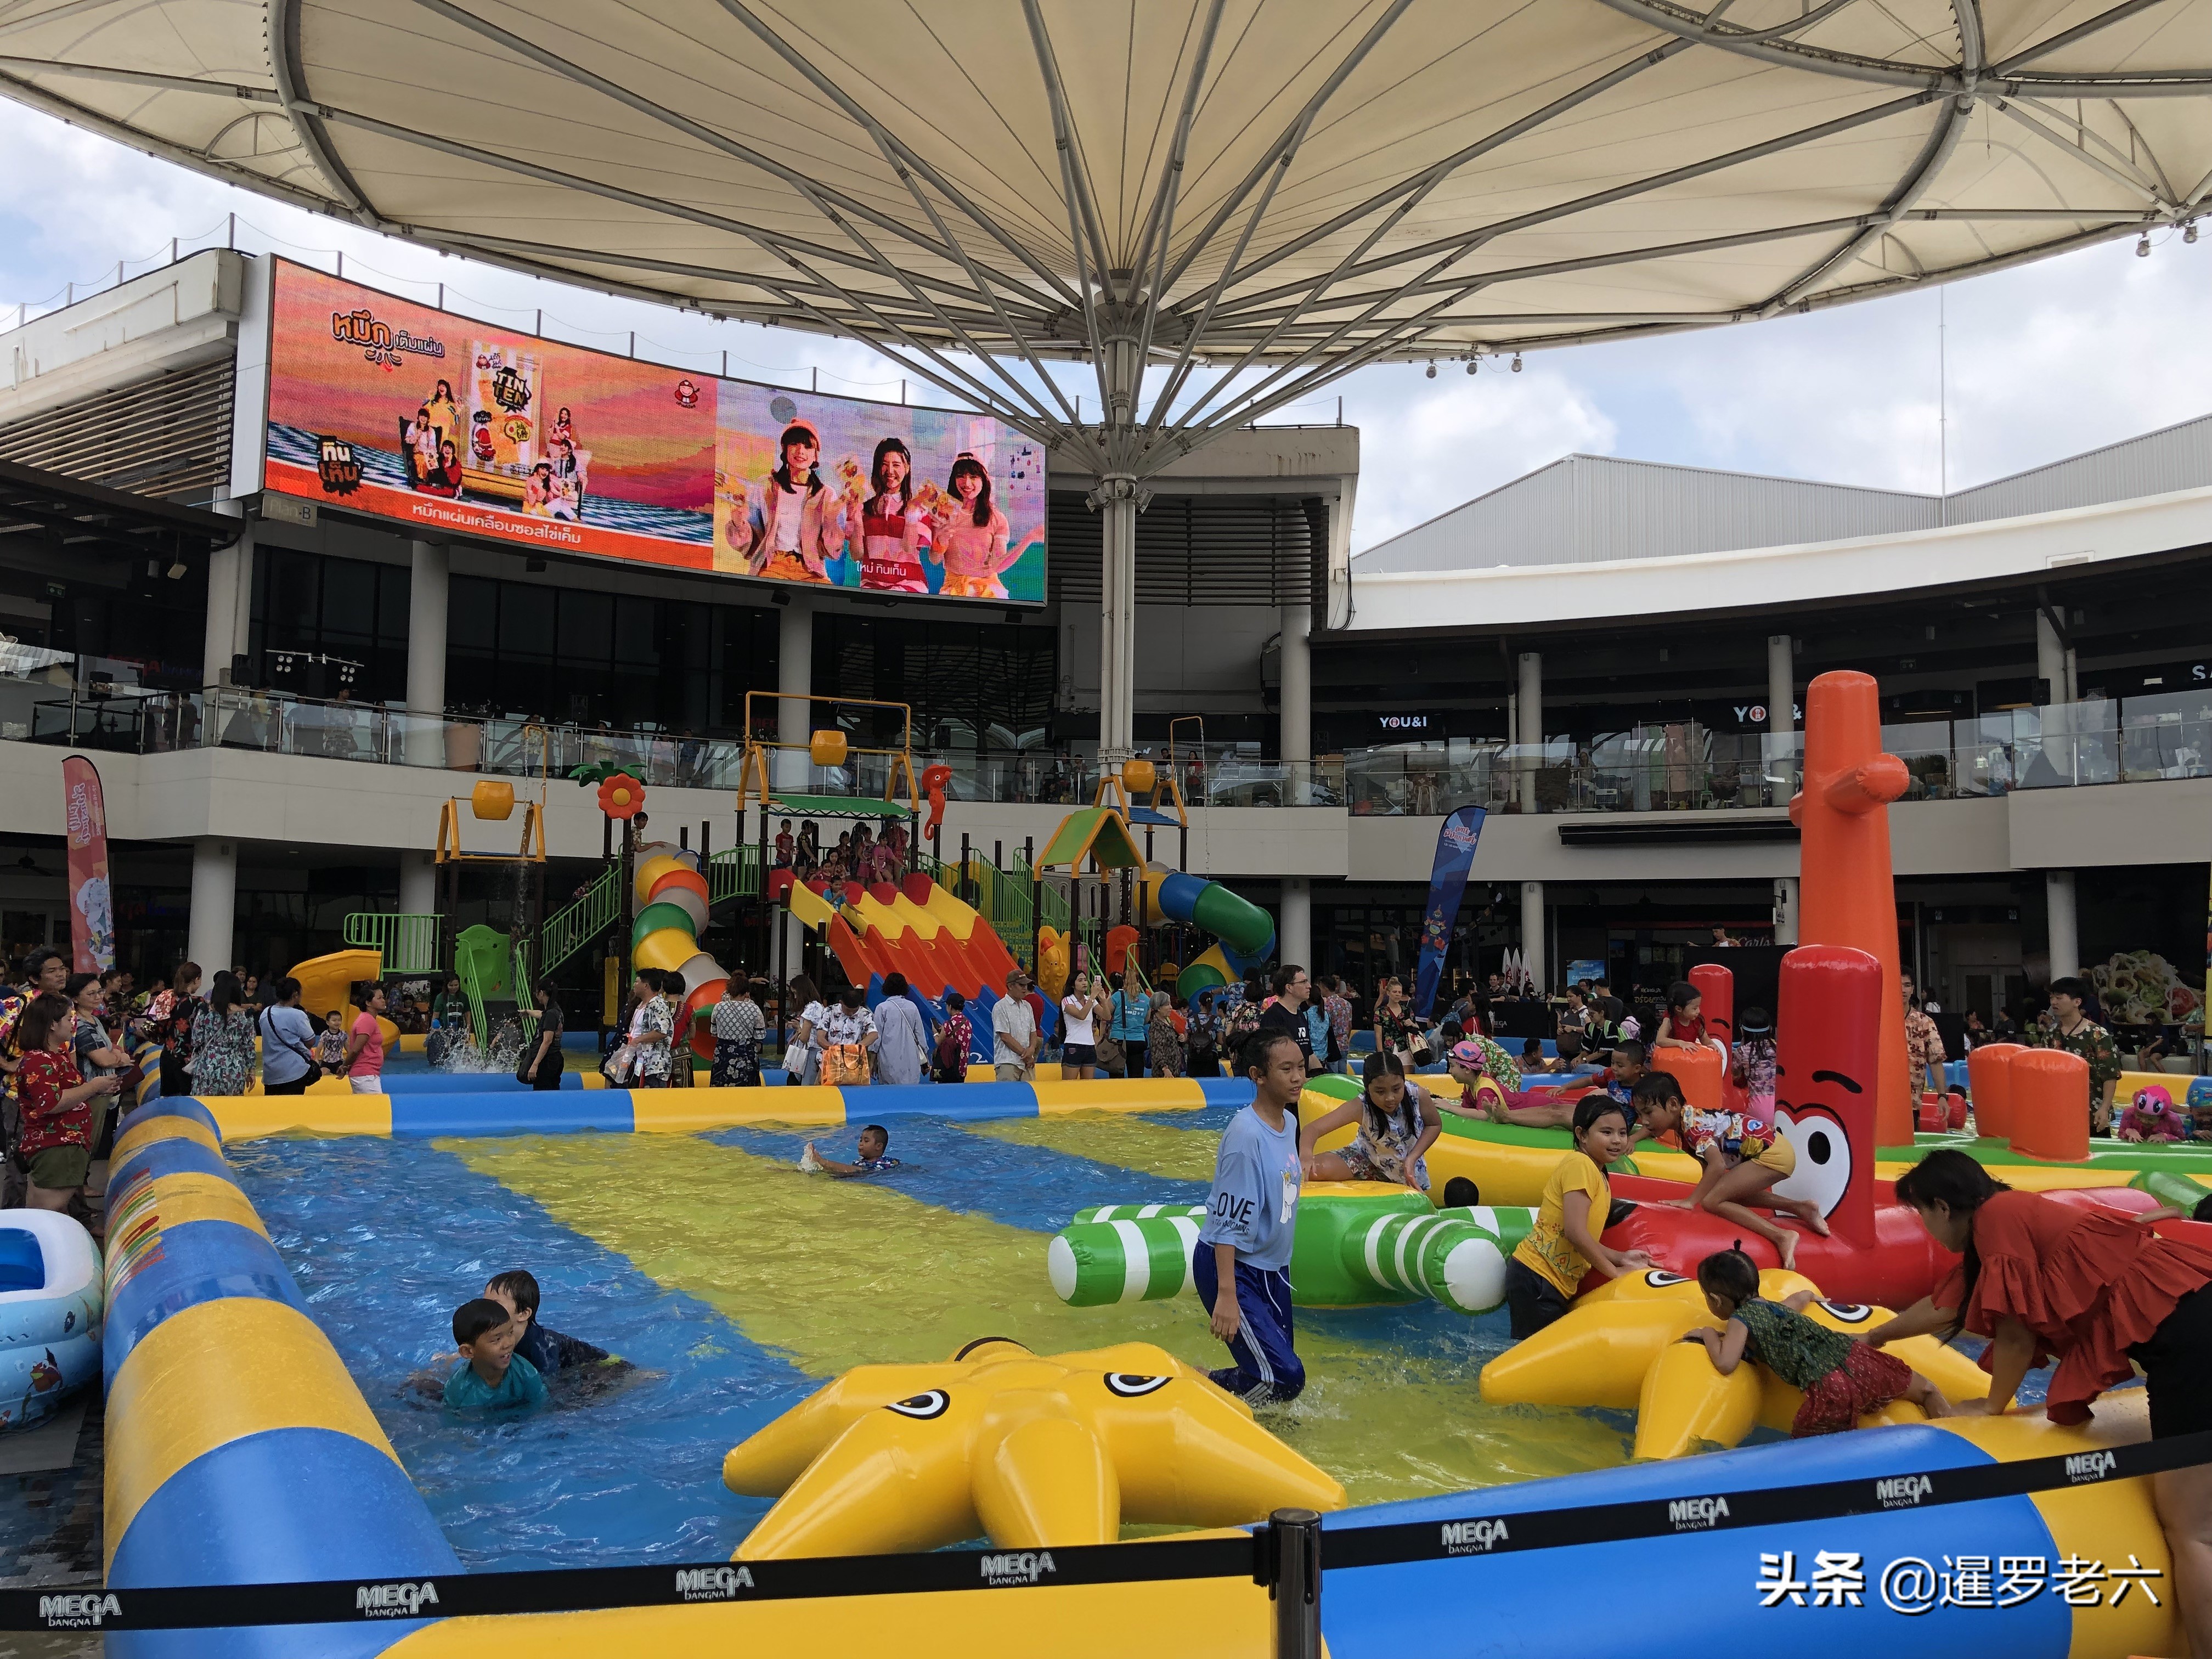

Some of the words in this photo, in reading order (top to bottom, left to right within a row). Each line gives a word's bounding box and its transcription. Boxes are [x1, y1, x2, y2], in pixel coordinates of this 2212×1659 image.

[332, 309, 392, 349] หมึก
[394, 330, 444, 357] เต็มแผ่น
[494, 384, 525, 405] TEN
[498, 373, 524, 393] TIN
[413, 502, 581, 544] หมึกแผ่นเคลือบซอสไข่เค็ม
[856, 560, 873, 573] ใหม่
[876, 563, 906, 576] ทินเท็น
[1379, 716, 1427, 728] YOU&I
[969, 1052, 988, 1063] 2
[933, 1069, 943, 1078] K
[1213, 1192, 1255, 1225] OVE
[2066, 1451, 2117, 1478] MEGA
[1877, 1475, 1932, 1504] MEGA
[1669, 1497, 1730, 1526] MEGA
[1442, 1519, 1509, 1550] MEGA
[981, 1552, 1056, 1582] MEGA
[676, 1566, 755, 1598] MEGA
[40, 1594, 122, 1626] MEGA
[356, 1582, 439, 1614] MEGA
